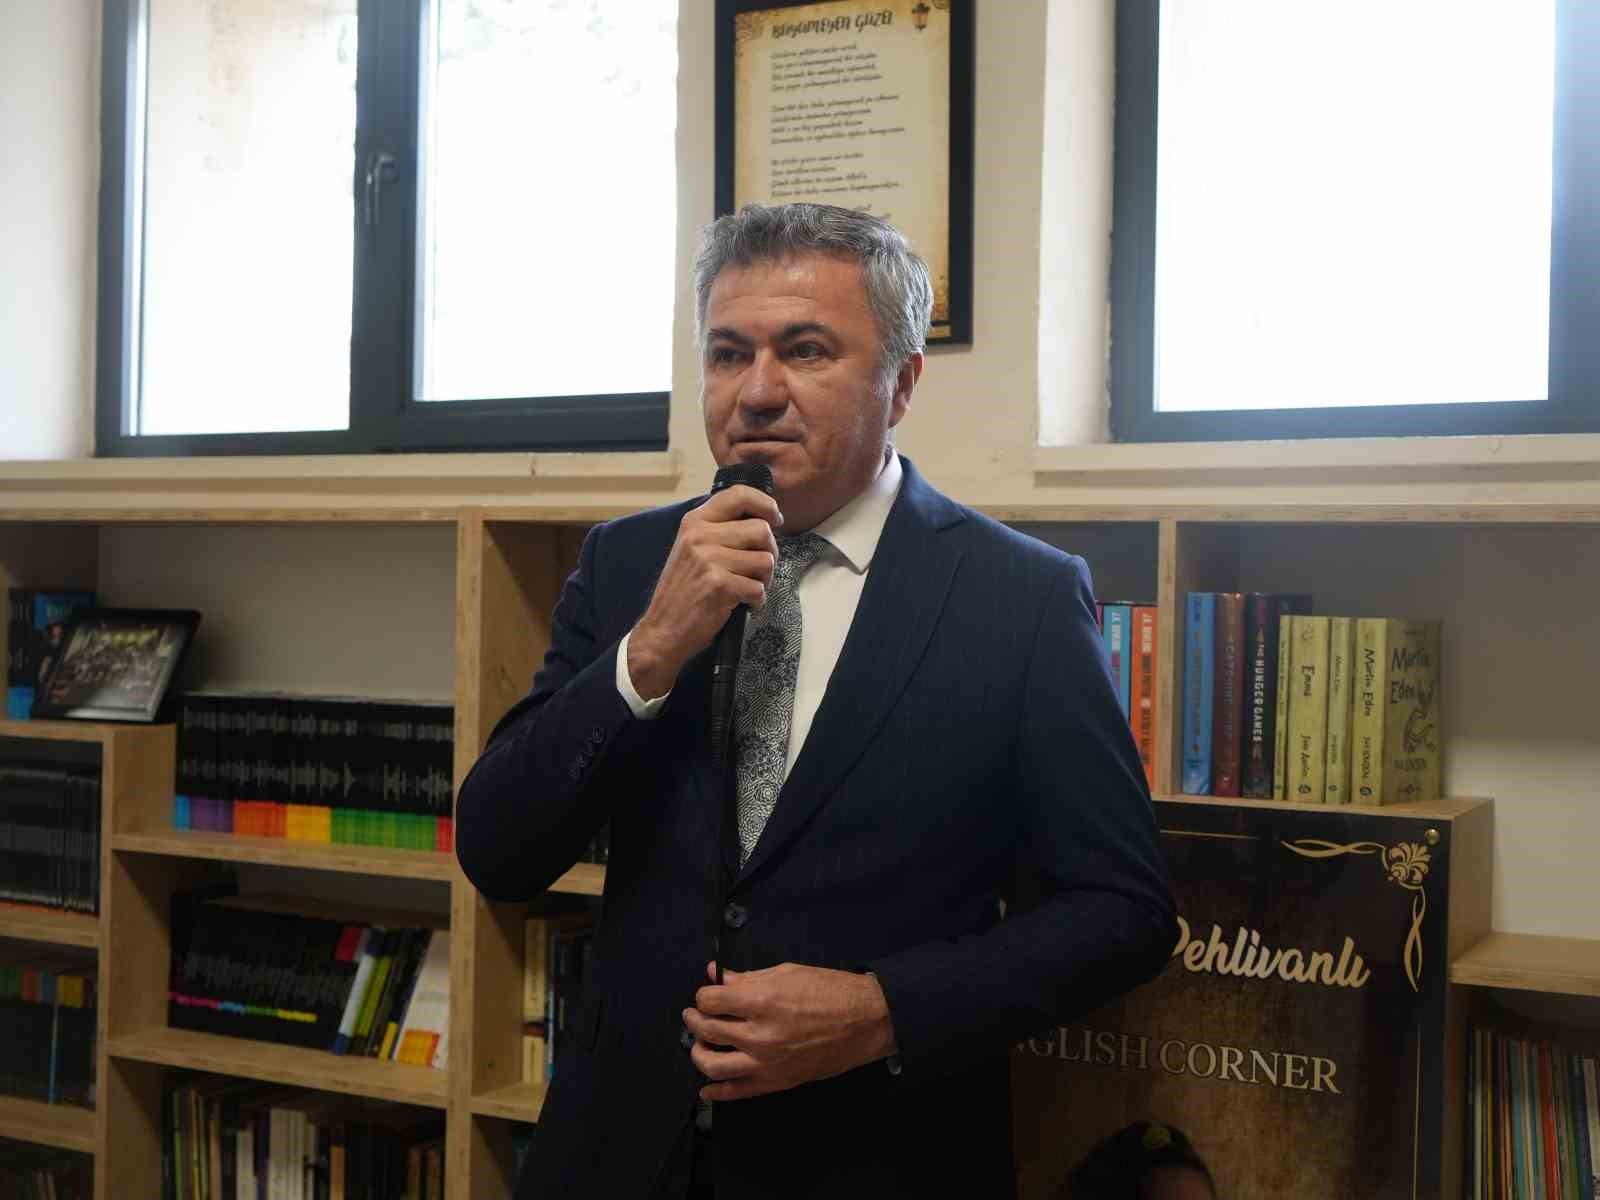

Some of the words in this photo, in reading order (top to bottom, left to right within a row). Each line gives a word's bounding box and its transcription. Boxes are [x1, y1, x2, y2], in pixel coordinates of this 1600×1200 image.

[1254, 660, 1265, 705] HUNGER
[1364, 648, 1376, 688] Martin
[1253, 707, 1264, 742] GAMES
[1016, 1027, 1149, 1069] GLISH
[1160, 1040, 1344, 1095] CORNER
